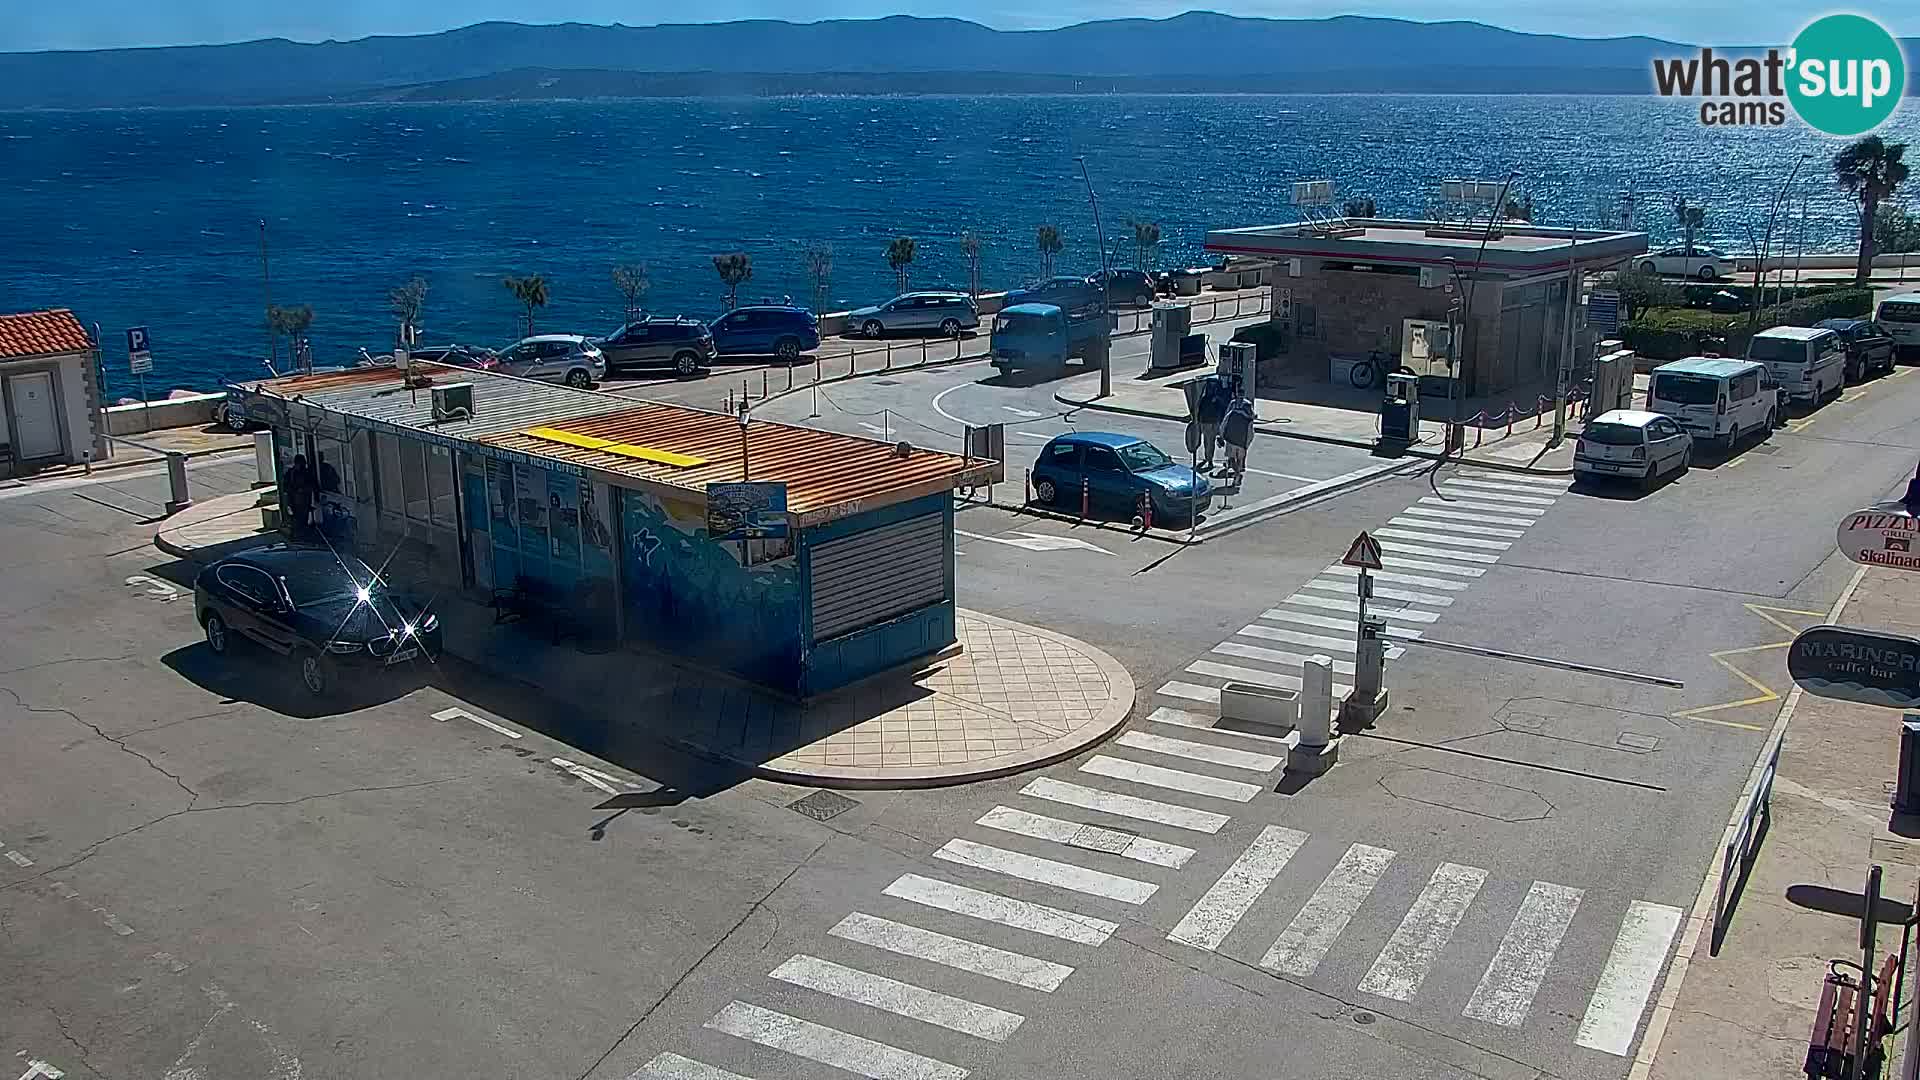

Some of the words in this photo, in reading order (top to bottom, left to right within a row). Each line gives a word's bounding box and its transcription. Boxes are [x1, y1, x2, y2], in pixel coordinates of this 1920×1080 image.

[495, 450, 527, 464] STATION
[529, 457, 555, 471] TICKET
[556, 462, 583, 477] OFFICE
[1848, 514, 1920, 532] PIZZE
[1828, 661, 1865, 673] caffe
[1870, 665, 1897, 679] bar
